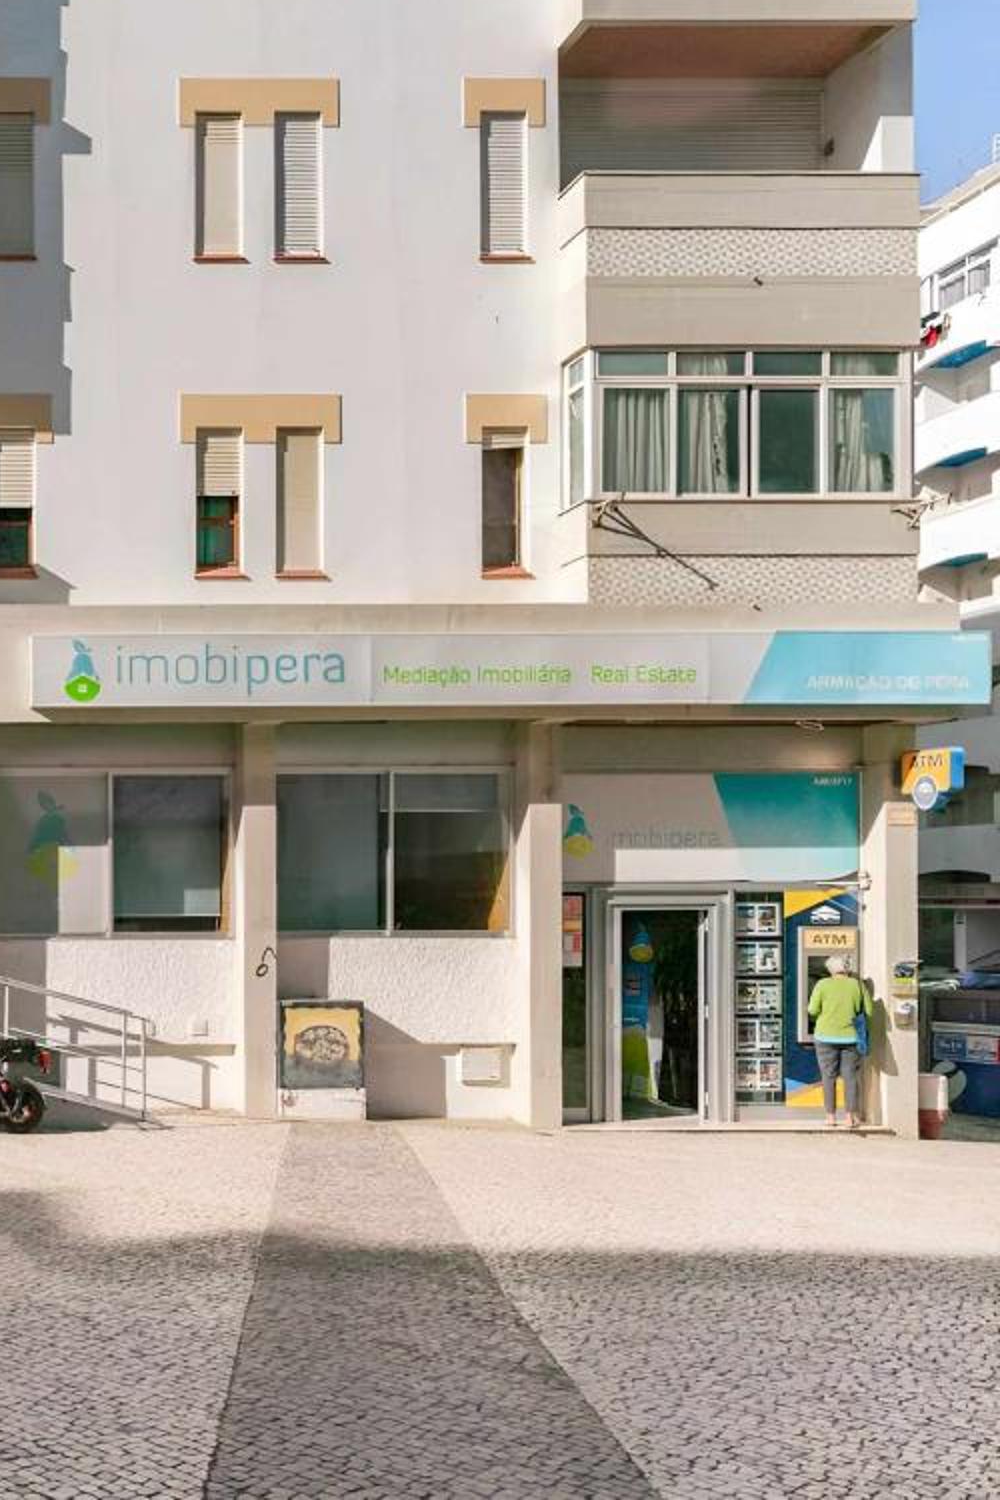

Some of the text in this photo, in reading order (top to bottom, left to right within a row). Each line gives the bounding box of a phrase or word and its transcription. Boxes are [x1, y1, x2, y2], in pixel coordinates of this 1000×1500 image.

[116, 643, 345, 697] imobipera
[383, 664, 697, 687] Mediação Imobiliária Real Estate
[910, 753, 943, 768] ATM
[813, 934, 847, 946] ATM
